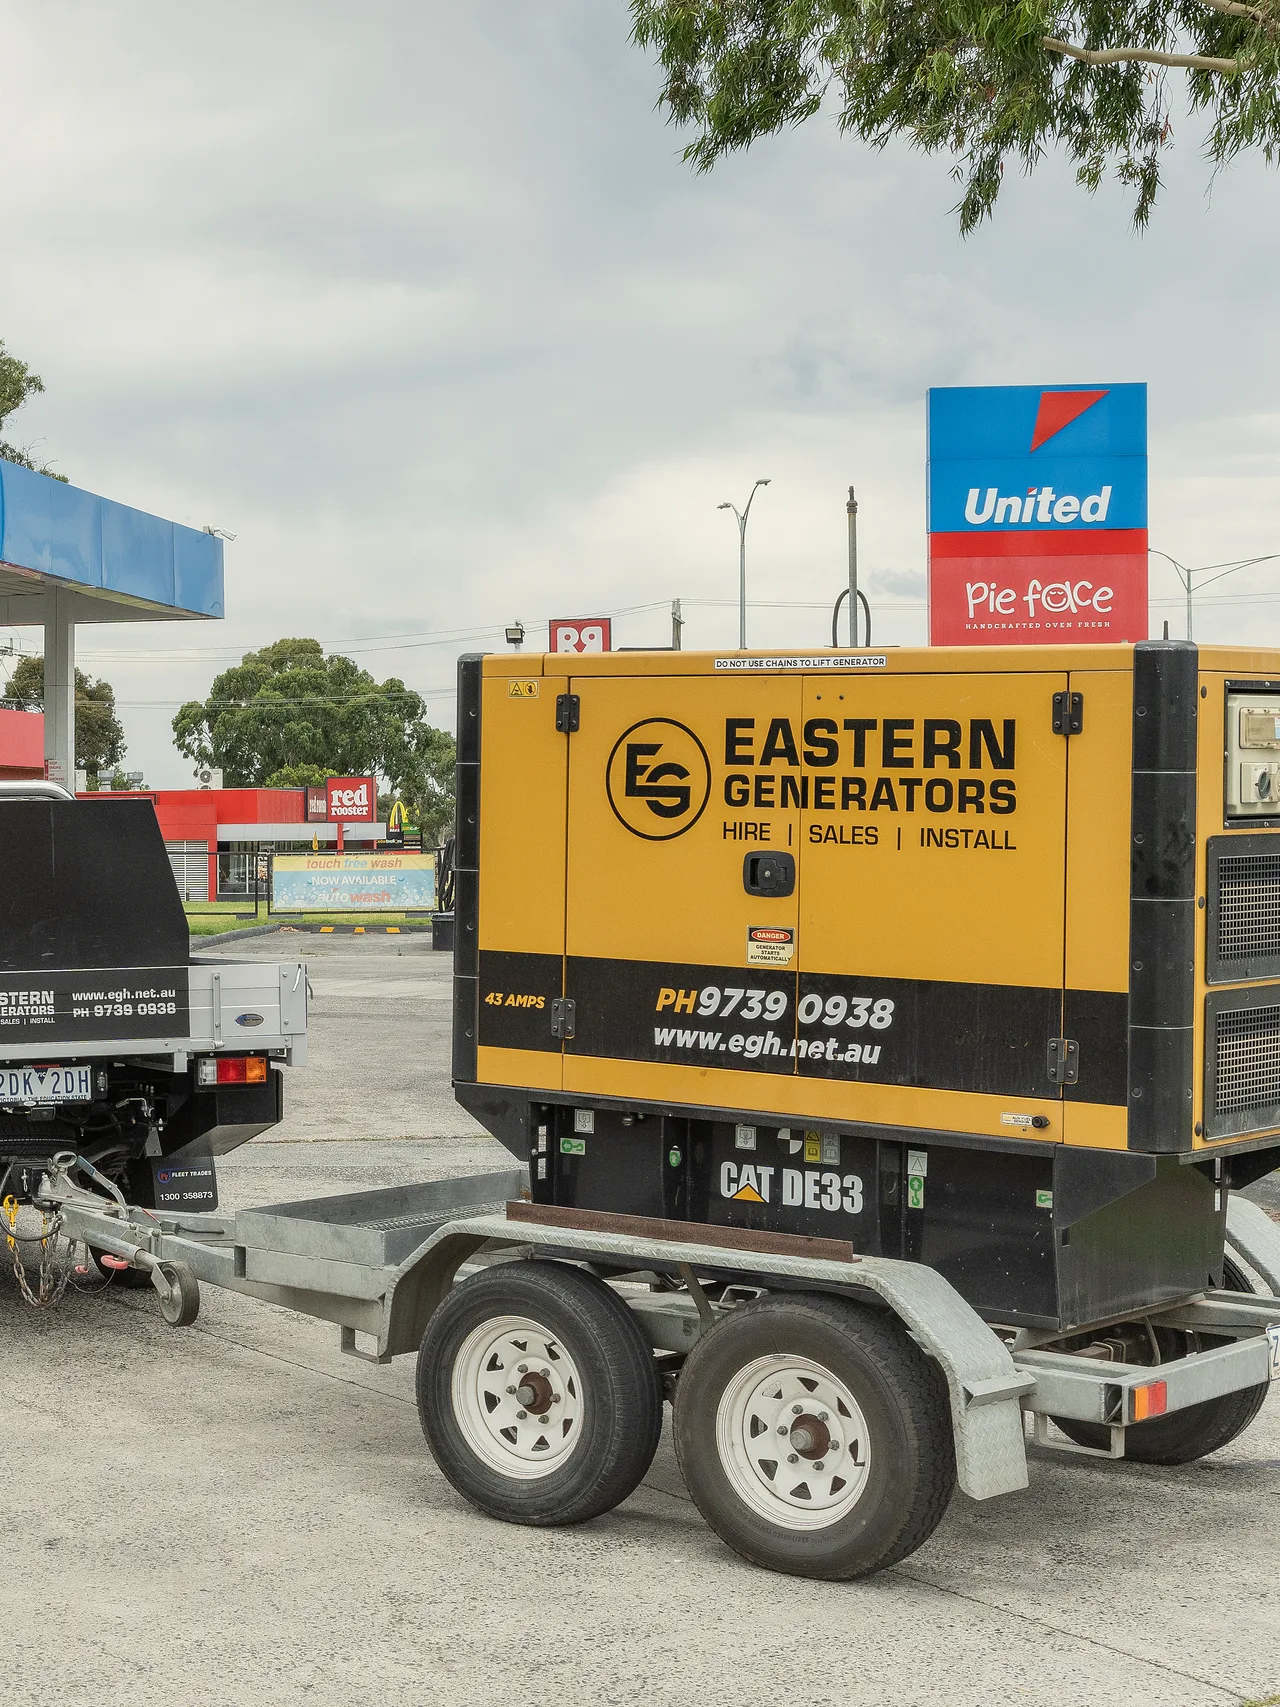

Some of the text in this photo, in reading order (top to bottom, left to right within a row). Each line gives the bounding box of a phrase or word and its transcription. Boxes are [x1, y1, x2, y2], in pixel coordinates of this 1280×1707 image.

[964, 485, 1113, 525] United
[966, 579, 1114, 619] Pie face
[965, 622, 1041, 630] HANDCRAFTED
[1045, 621, 1073, 629] OVEN
[716, 657, 885, 668] DO NOT USE CHAINS TO LIFT GENERATOR
[724, 717, 1017, 770] EASTERN
[331, 783, 369, 806] red
[723, 773, 1017, 815] GENERATORS
[331, 806, 369, 816] rooster
[722, 821, 1017, 850] HIRE SALES INSTALL
[306, 857, 403, 869] touch free wash
[311, 875, 397, 885] NOW AVAILABLE
[317, 889, 391, 903] autowash
[72, 987, 176, 1002] www.egh.net.au
[484, 991, 546, 1009] 43 AMPS
[73, 1002, 177, 1018] PH 9739 0938
[797, 995, 896, 1030] 0938
[0, 1018, 20, 1026] SALES
[29, 1017, 56, 1025] INSTALL
[654, 1027, 882, 1065] www.egh.net.au
[51, 1070, 89, 1094] 2DH
[160, 1191, 213, 1201] 1300 358873
[720, 1161, 864, 1215] CAT DE33
